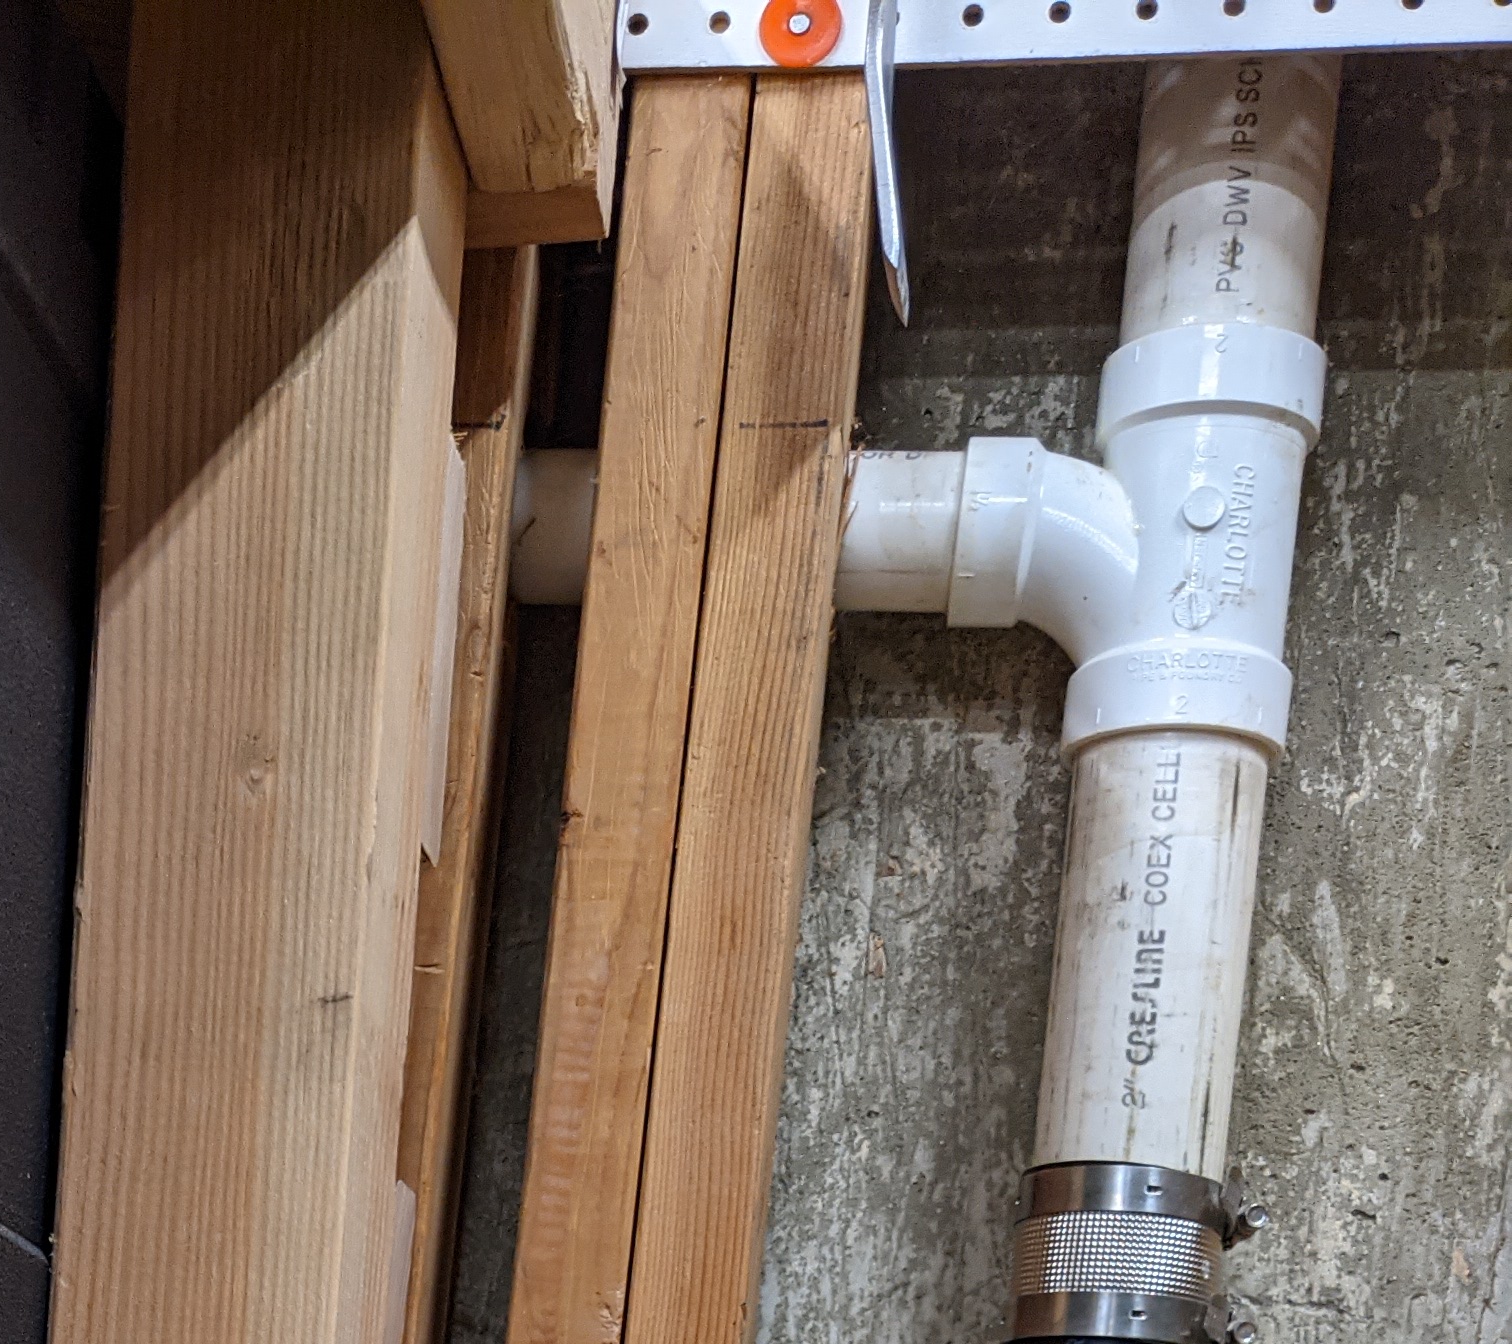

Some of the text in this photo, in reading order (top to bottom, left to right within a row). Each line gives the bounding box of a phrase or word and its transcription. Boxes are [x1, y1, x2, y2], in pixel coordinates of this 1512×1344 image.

[1230, 111, 1258, 153] IPS
[1222, 166, 1253, 226] DWV
[1221, 463, 1256, 601] CHARLOTTE
[1126, 651, 1250, 674] CHARLOTTE
[1175, 695, 1189, 715] 2
[1151, 748, 1182, 823] CELL
[1144, 834, 1173, 906] COEX
